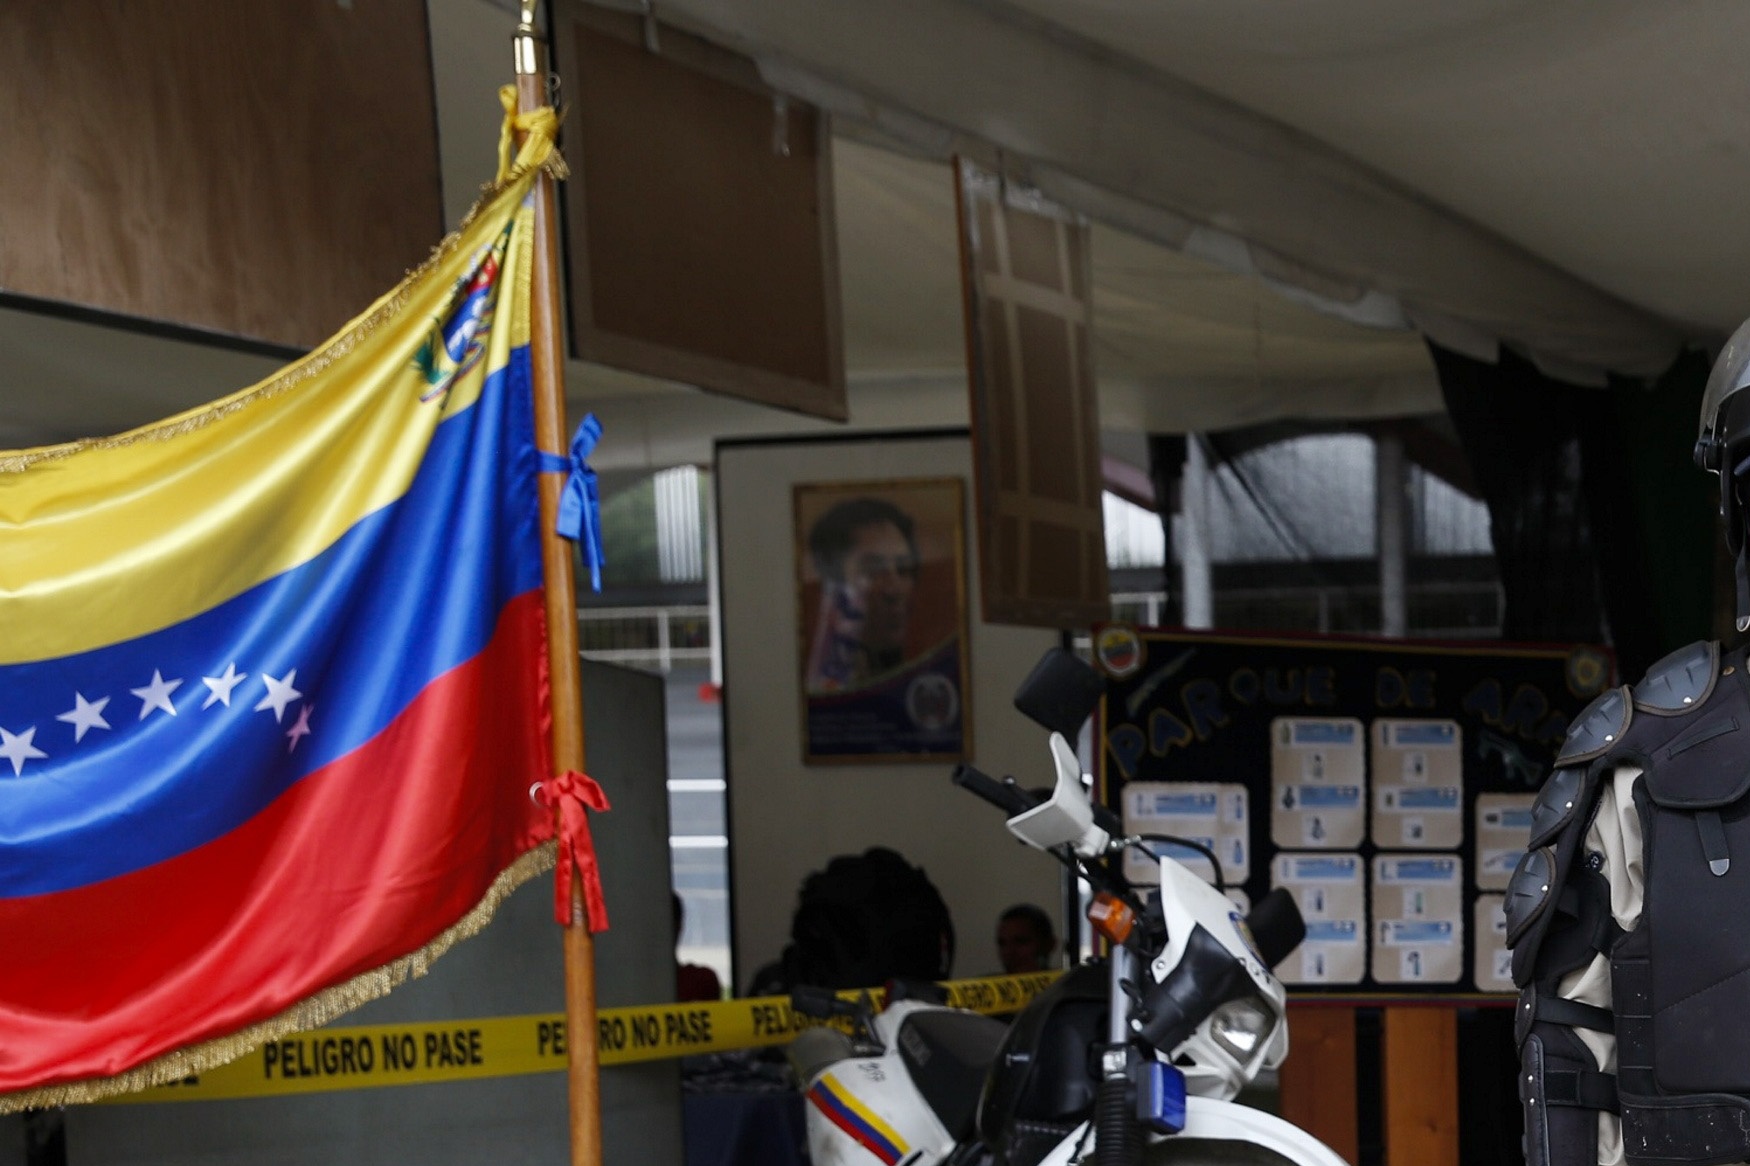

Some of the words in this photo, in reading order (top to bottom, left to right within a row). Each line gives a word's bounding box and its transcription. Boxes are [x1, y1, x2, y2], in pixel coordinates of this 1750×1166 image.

[1107, 663, 1338, 780] PARQUE
[1375, 665, 1438, 710] DE
[263, 1035, 375, 1080] PELIGRO
[382, 1033, 417, 1073] NO
[424, 1029, 484, 1069] PASE
[537, 1013, 628, 1057] PERO
[632, 1014, 661, 1048] NO
[665, 1009, 714, 1045] PASE
